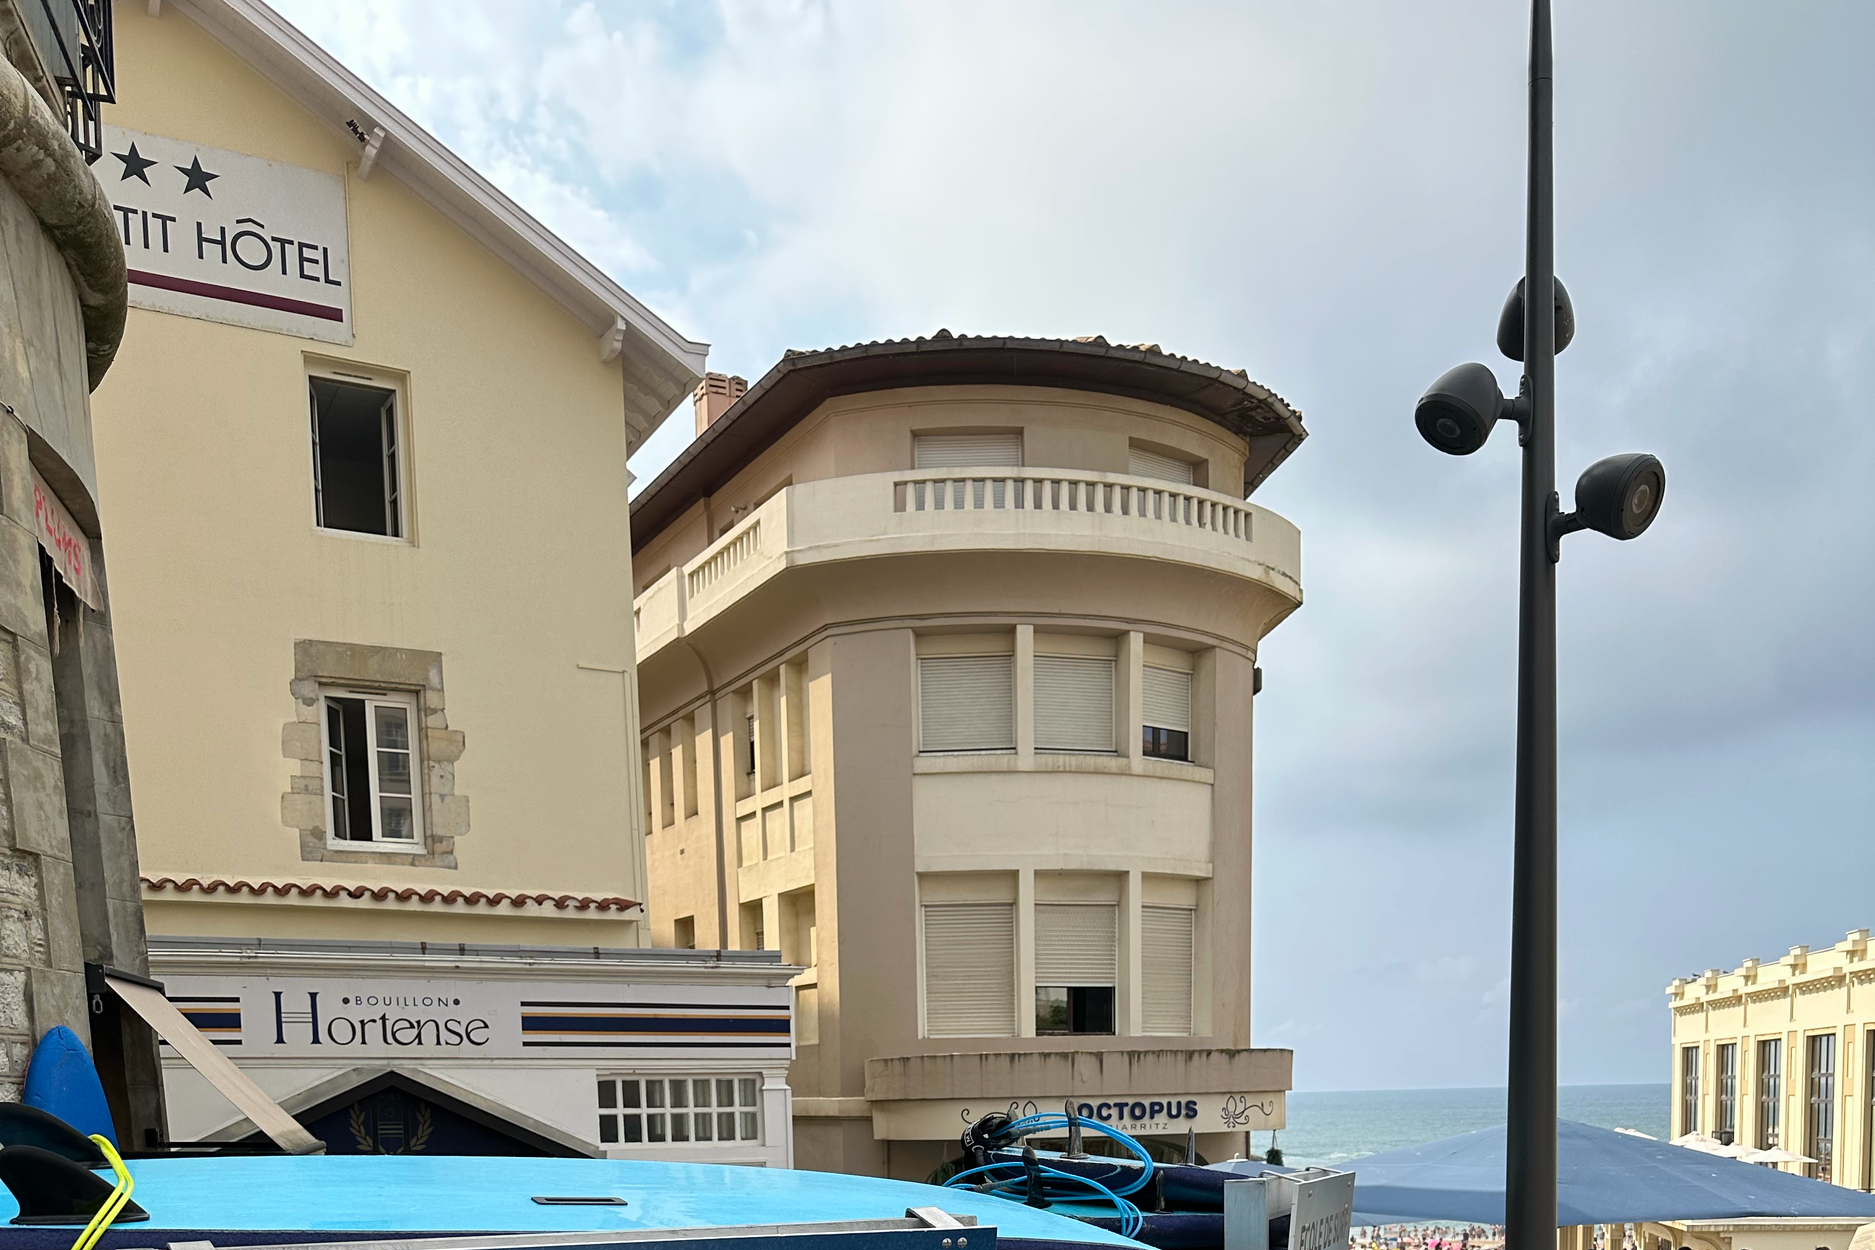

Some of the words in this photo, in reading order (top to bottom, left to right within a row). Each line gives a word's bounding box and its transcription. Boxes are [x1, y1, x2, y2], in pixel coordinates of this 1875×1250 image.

[196, 217, 342, 287] HÔTEL
[33, 481, 82, 576] PLUMS
[272, 991, 490, 1046] Hortense
[355, 995, 449, 1007] BOUILLON
[1077, 1100, 1198, 1121] OCTOPUS
